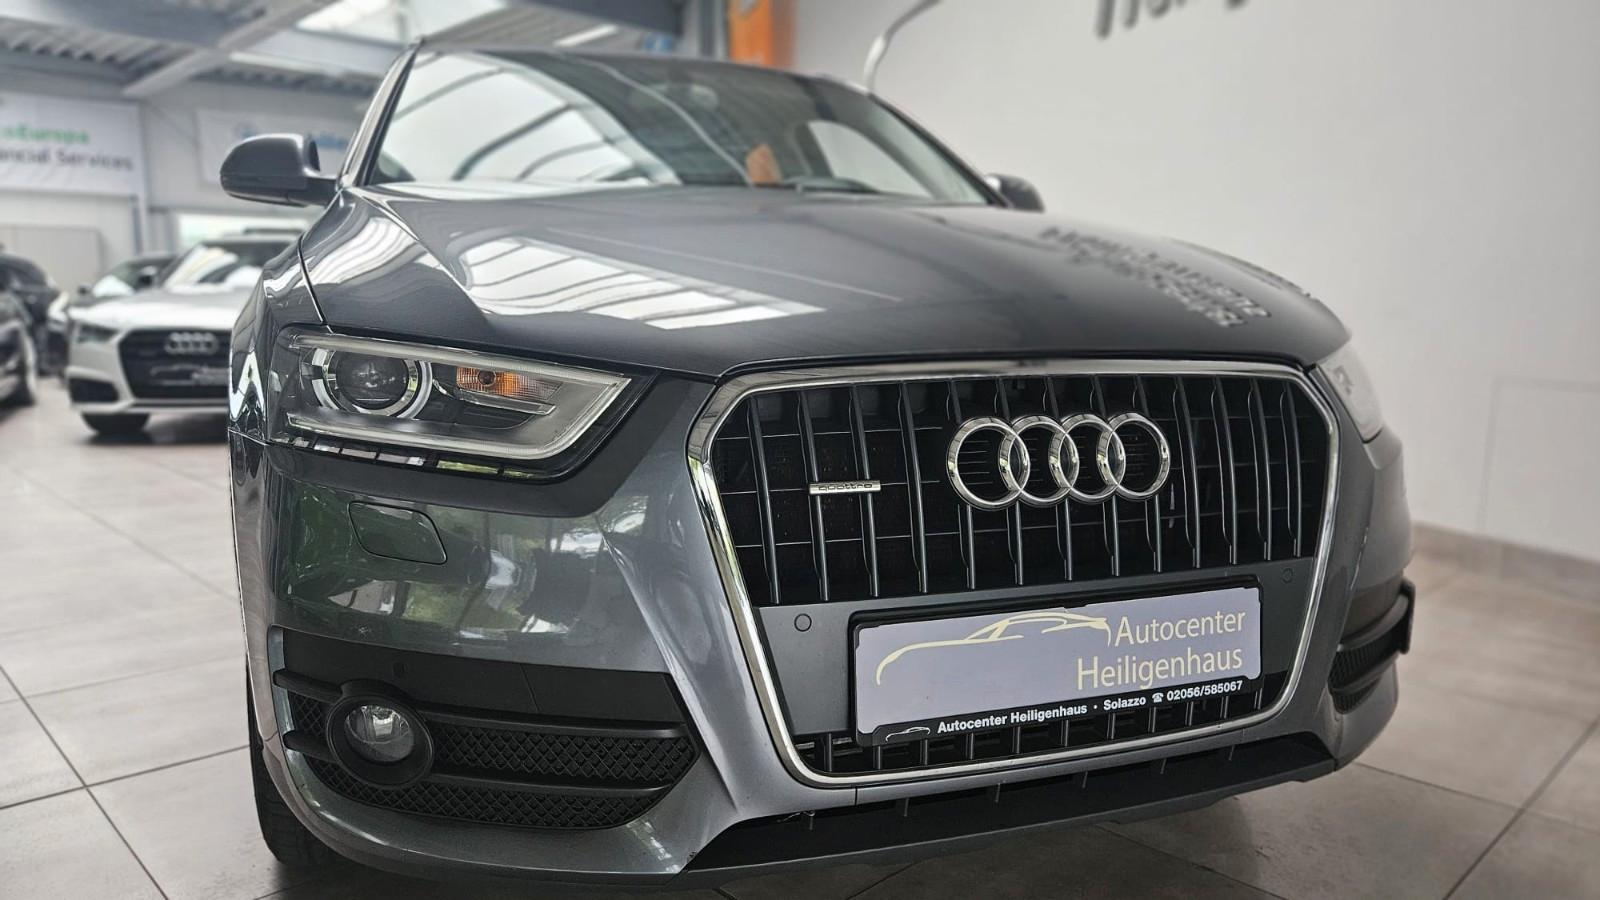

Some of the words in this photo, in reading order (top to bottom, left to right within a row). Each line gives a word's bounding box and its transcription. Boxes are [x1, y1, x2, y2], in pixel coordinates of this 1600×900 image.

[56, 148, 134, 171] Services
[818, 483, 873, 492] quattro
[1114, 610, 1247, 648] Autocenter
[1076, 646, 1243, 691] Heiligenhaus
[936, 714, 1008, 734] Autocenter
[1010, 704, 1088, 724] Heiligenhaus
[1103, 696, 1147, 711] Solazzo
[1166, 680, 1243, 701] 02056/585067
